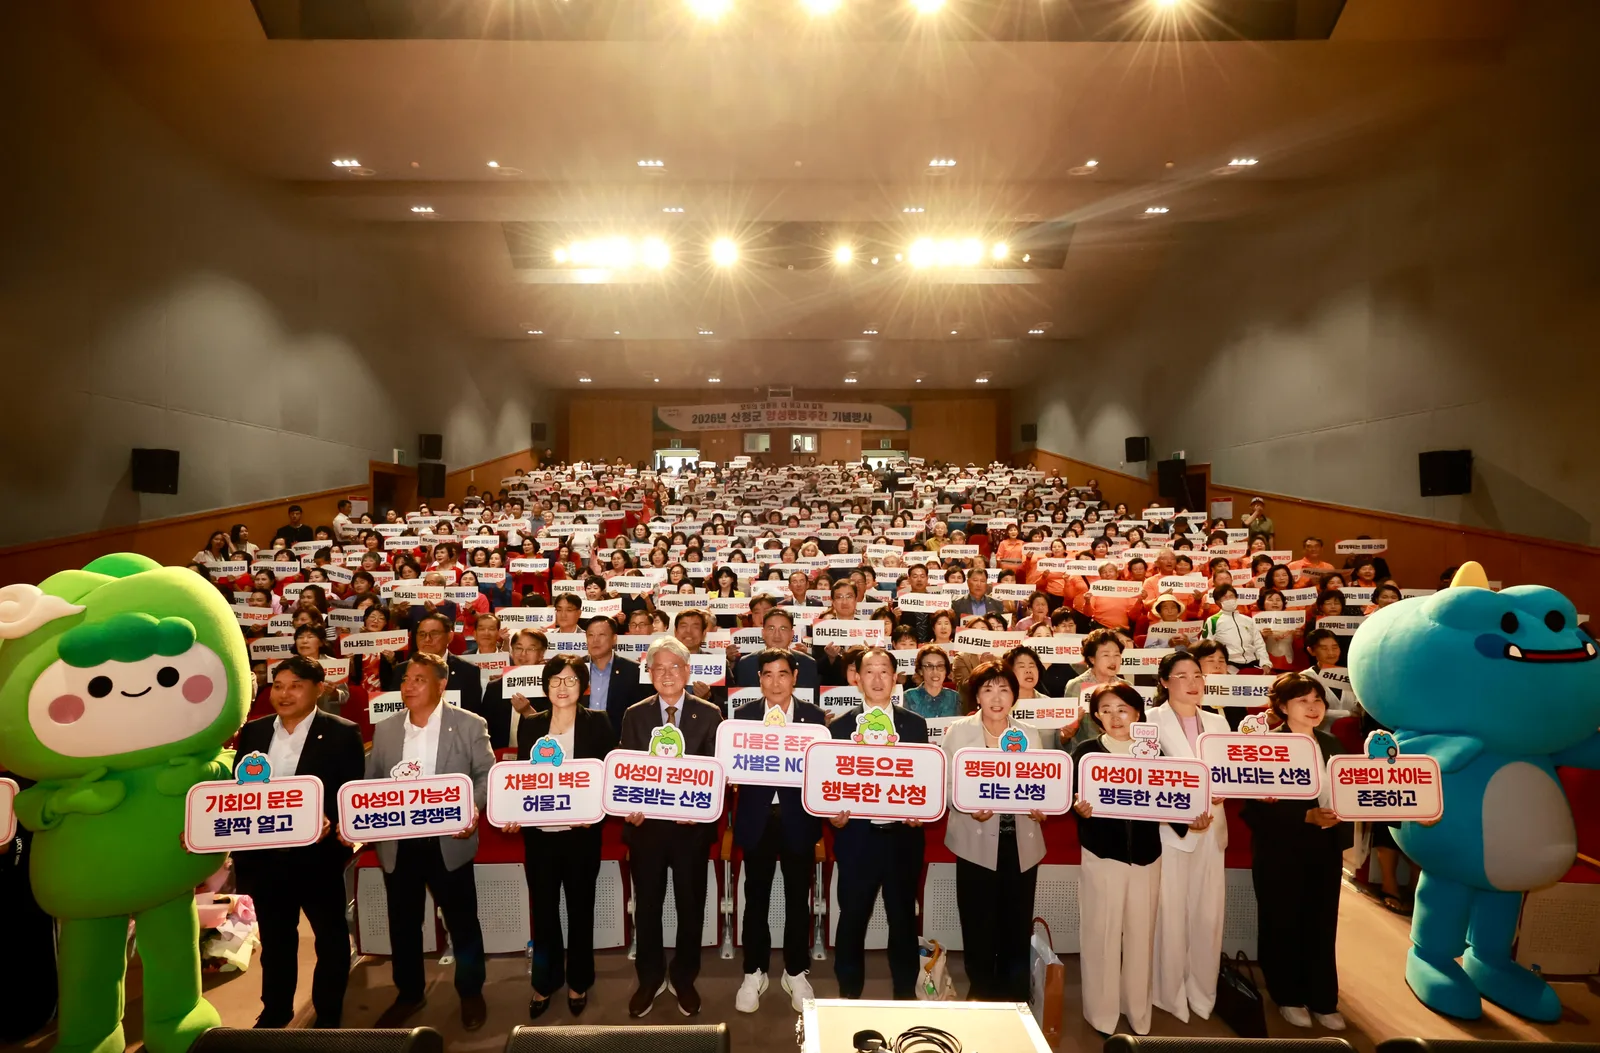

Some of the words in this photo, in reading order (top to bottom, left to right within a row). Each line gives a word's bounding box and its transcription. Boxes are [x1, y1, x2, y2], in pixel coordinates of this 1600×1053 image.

[692, 413, 726, 424] 2026년
[376, 636, 405, 646] 행복군민
[816, 628, 847, 637] 하나되는
[958, 636, 991, 647] 하나되는
[708, 640, 731, 649] 행복군
[1055, 646, 1082, 654] 행복군
[1322, 671, 1350, 683] 하나되
[374, 702, 404, 712] 함께뛰
[824, 696, 862, 706] 함께뛰는
[1036, 708, 1074, 719] 행복군민
[733, 732, 779, 750] 다름은
[1135, 728, 1155, 736] Good
[732, 754, 780, 772] 차별은
[1227, 745, 1290, 763] 존중으로
[614, 763, 662, 784] 여성의
[666, 767, 714, 787] 권익이
[835, 755, 914, 778] 평등으로
[964, 760, 1011, 778] 평등이
[1015, 762, 1061, 780] 일상이
[1211, 766, 1274, 785] 하나되는
[1278, 768, 1311, 785] 산청
[504, 772, 553, 791] 차별의
[559, 771, 590, 789] 벽은
[1091, 765, 1142, 785] 여성이
[1148, 769, 1200, 788] 꿈꾸는
[1338, 768, 1384, 785] 성별의
[1387, 768, 1432, 785] 차이는
[352, 790, 404, 809] 여성의
[408, 786, 460, 805] 가능성
[612, 785, 675, 806] 존중받는
[679, 790, 712, 809] 산청
[821, 780, 881, 803] 행복한
[886, 784, 926, 805] 산청
[979, 783, 1010, 800] 되는
[1014, 783, 1046, 800] 산청
[1098, 787, 1150, 807] 평등한
[1155, 791, 1191, 809] 산청
[1357, 790, 1417, 806] 존중하고
[206, 792, 261, 813] 기회의
[267, 790, 303, 810] 문은
[523, 794, 571, 812] 허물고
[214, 817, 251, 837] 활짝
[257, 814, 293, 834] 열고
[352, 811, 405, 830] 산청의
[410, 806, 461, 824] 경쟁력
